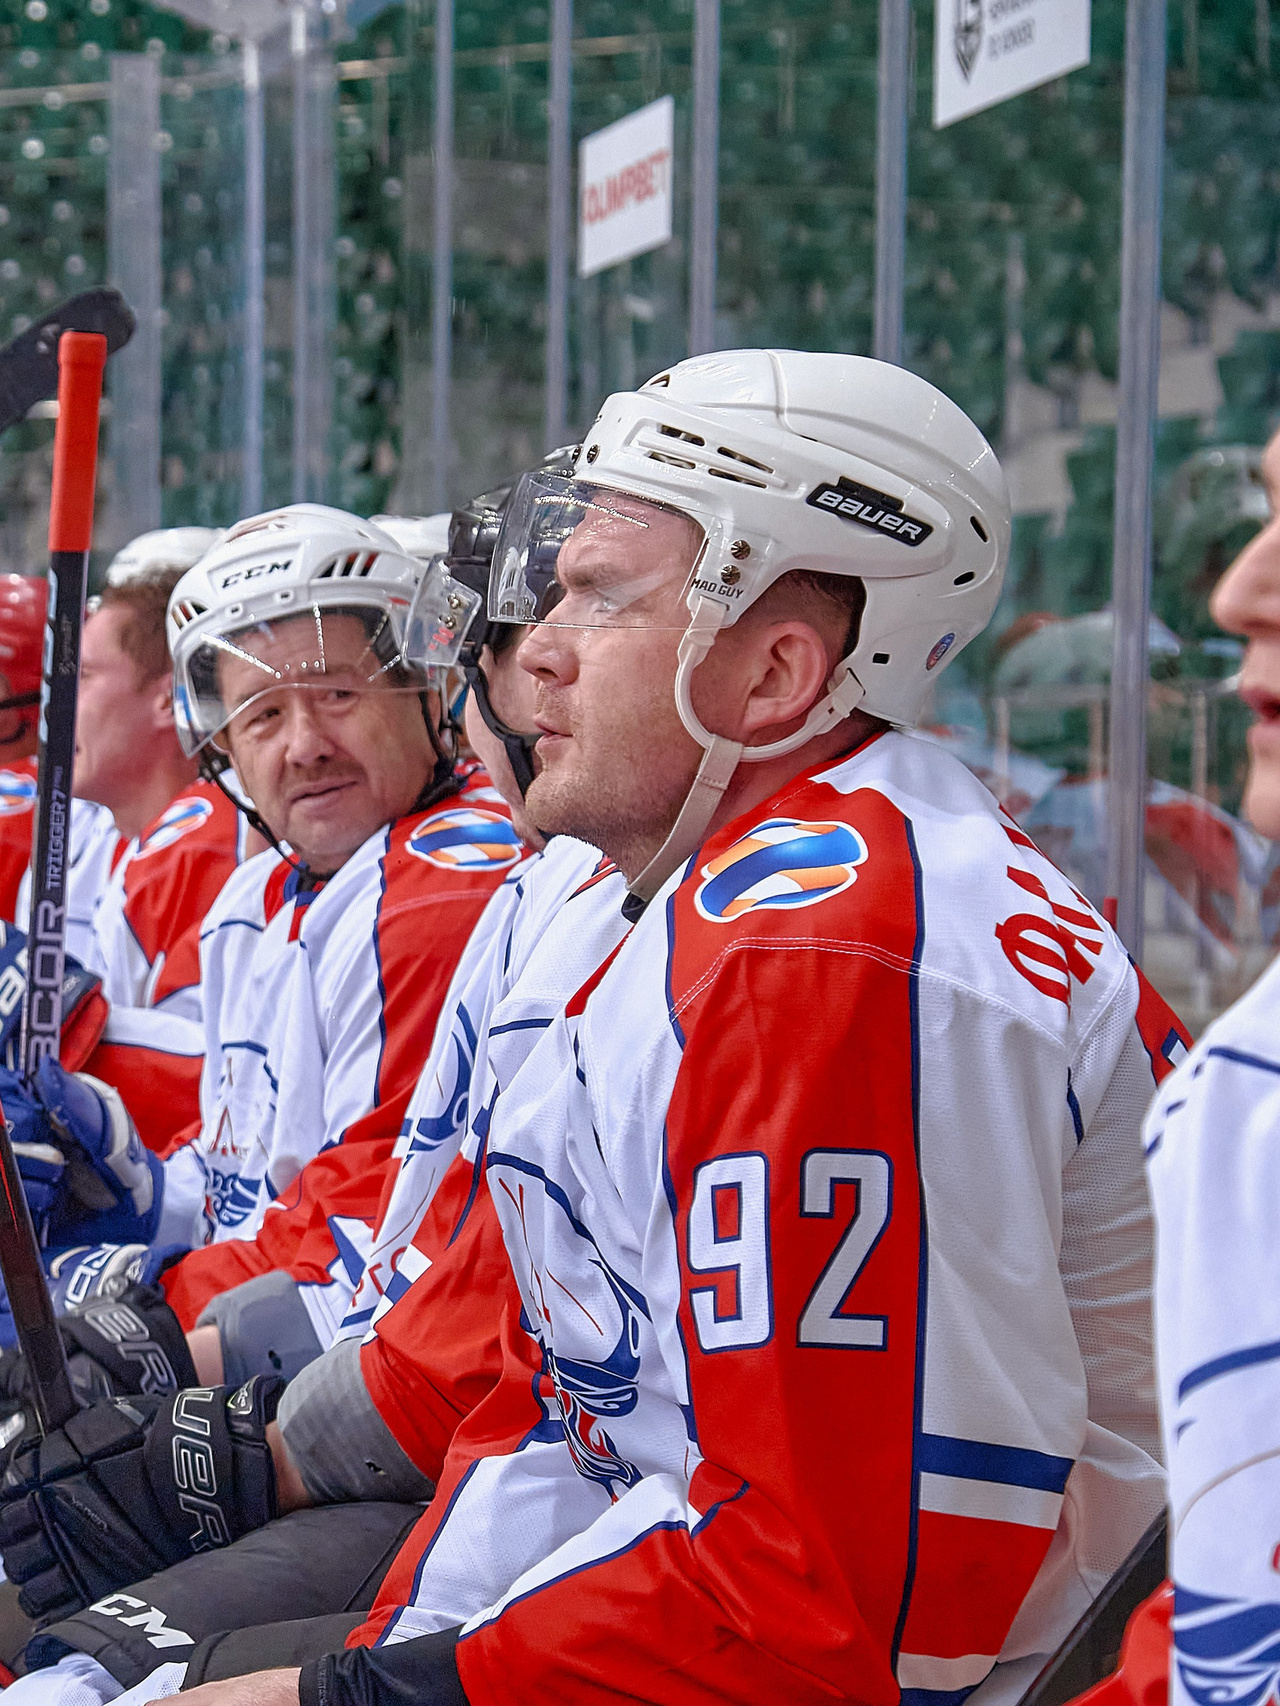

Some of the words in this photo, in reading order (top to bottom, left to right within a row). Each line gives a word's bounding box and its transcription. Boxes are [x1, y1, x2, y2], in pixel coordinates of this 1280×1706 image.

[816, 490, 922, 540] BAUER
[222, 559, 293, 588] CCM
[691, 578, 717, 593] MAD
[718, 584, 744, 599] GUY
[687, 1147, 894, 1355] 92
